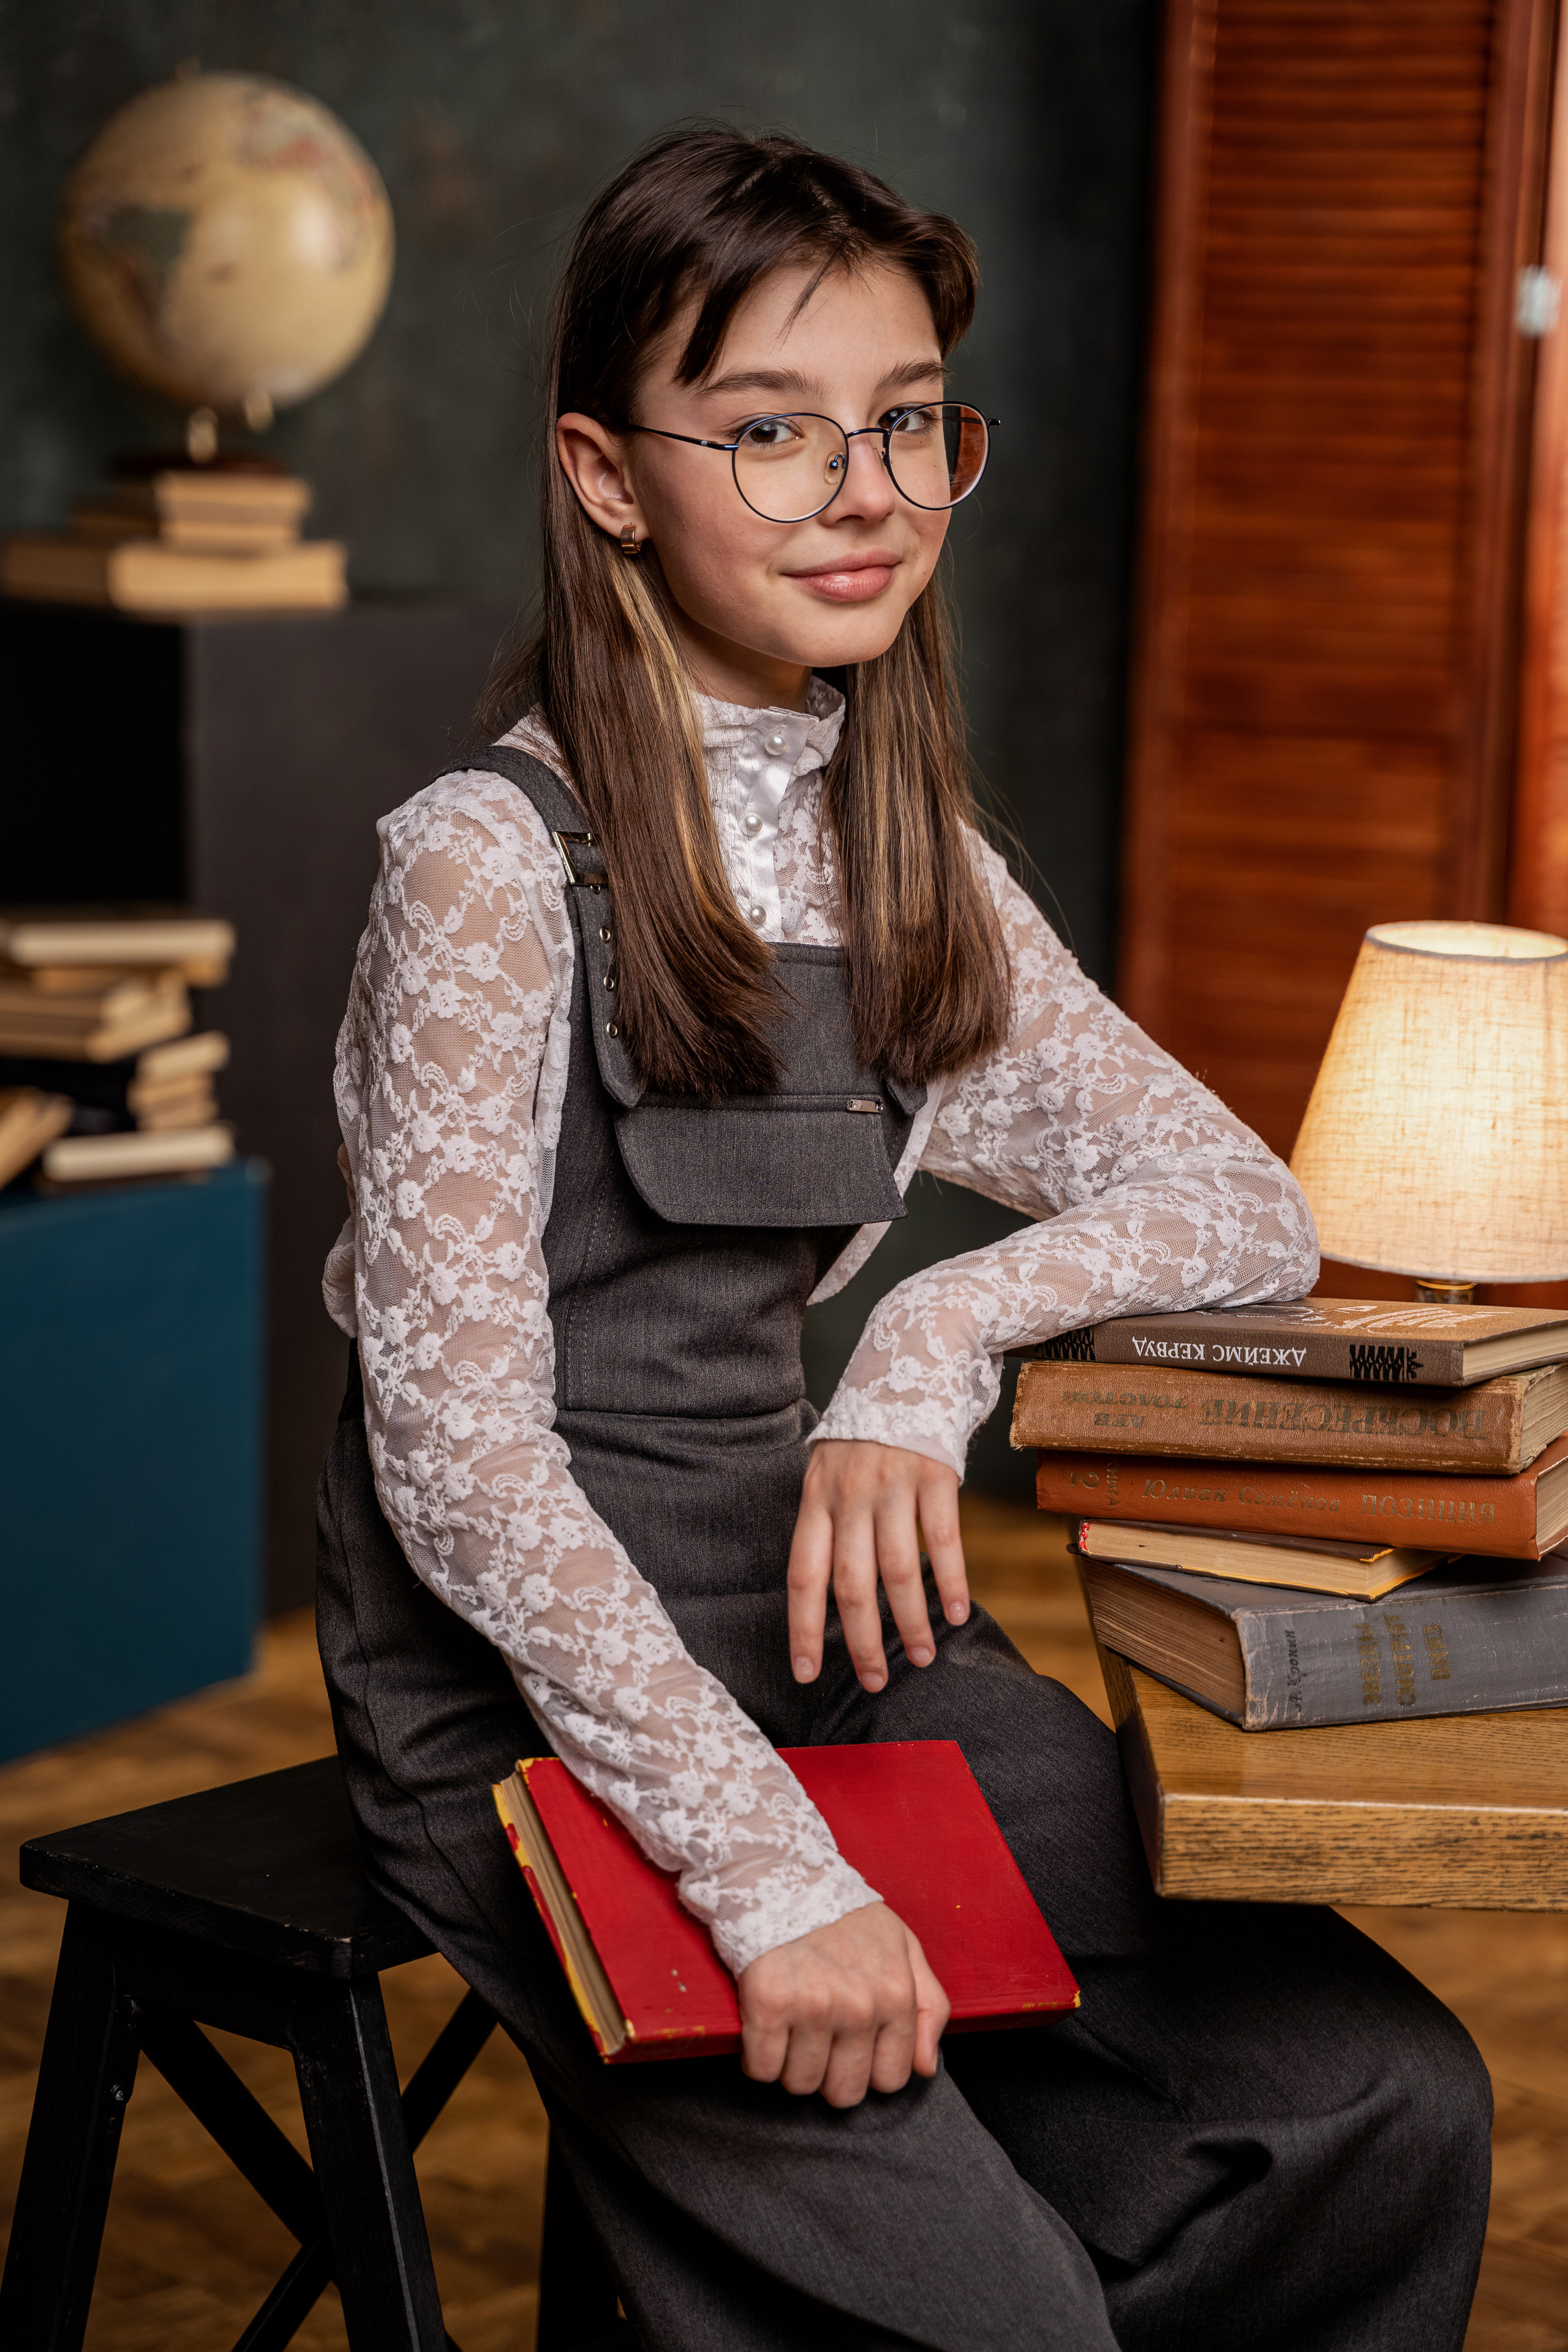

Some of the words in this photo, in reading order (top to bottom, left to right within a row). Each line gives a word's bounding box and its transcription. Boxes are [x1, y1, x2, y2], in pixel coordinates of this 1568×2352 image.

[1133, 1336, 1205, 1360] КЕРВУД
[1212, 1344, 1306, 1367] ДЖЕЙМС
[1197, 1399, 1488, 1439] ВОСКРЕСЕНИЕ
[1069, 1471, 1101, 1490] 2
[1142, 1478, 1227, 1502] Юлиан
[1238, 1486, 1342, 1513] Семёнов
[1362, 1494, 1495, 1524] ПОЗИЦИЯ
[1354, 1623, 1382, 1707] ЗВЕЗДЫ
[1382, 1612, 1417, 1708] СМОТРЯТ
[1423, 1623, 1452, 1682] ВНИЗ
